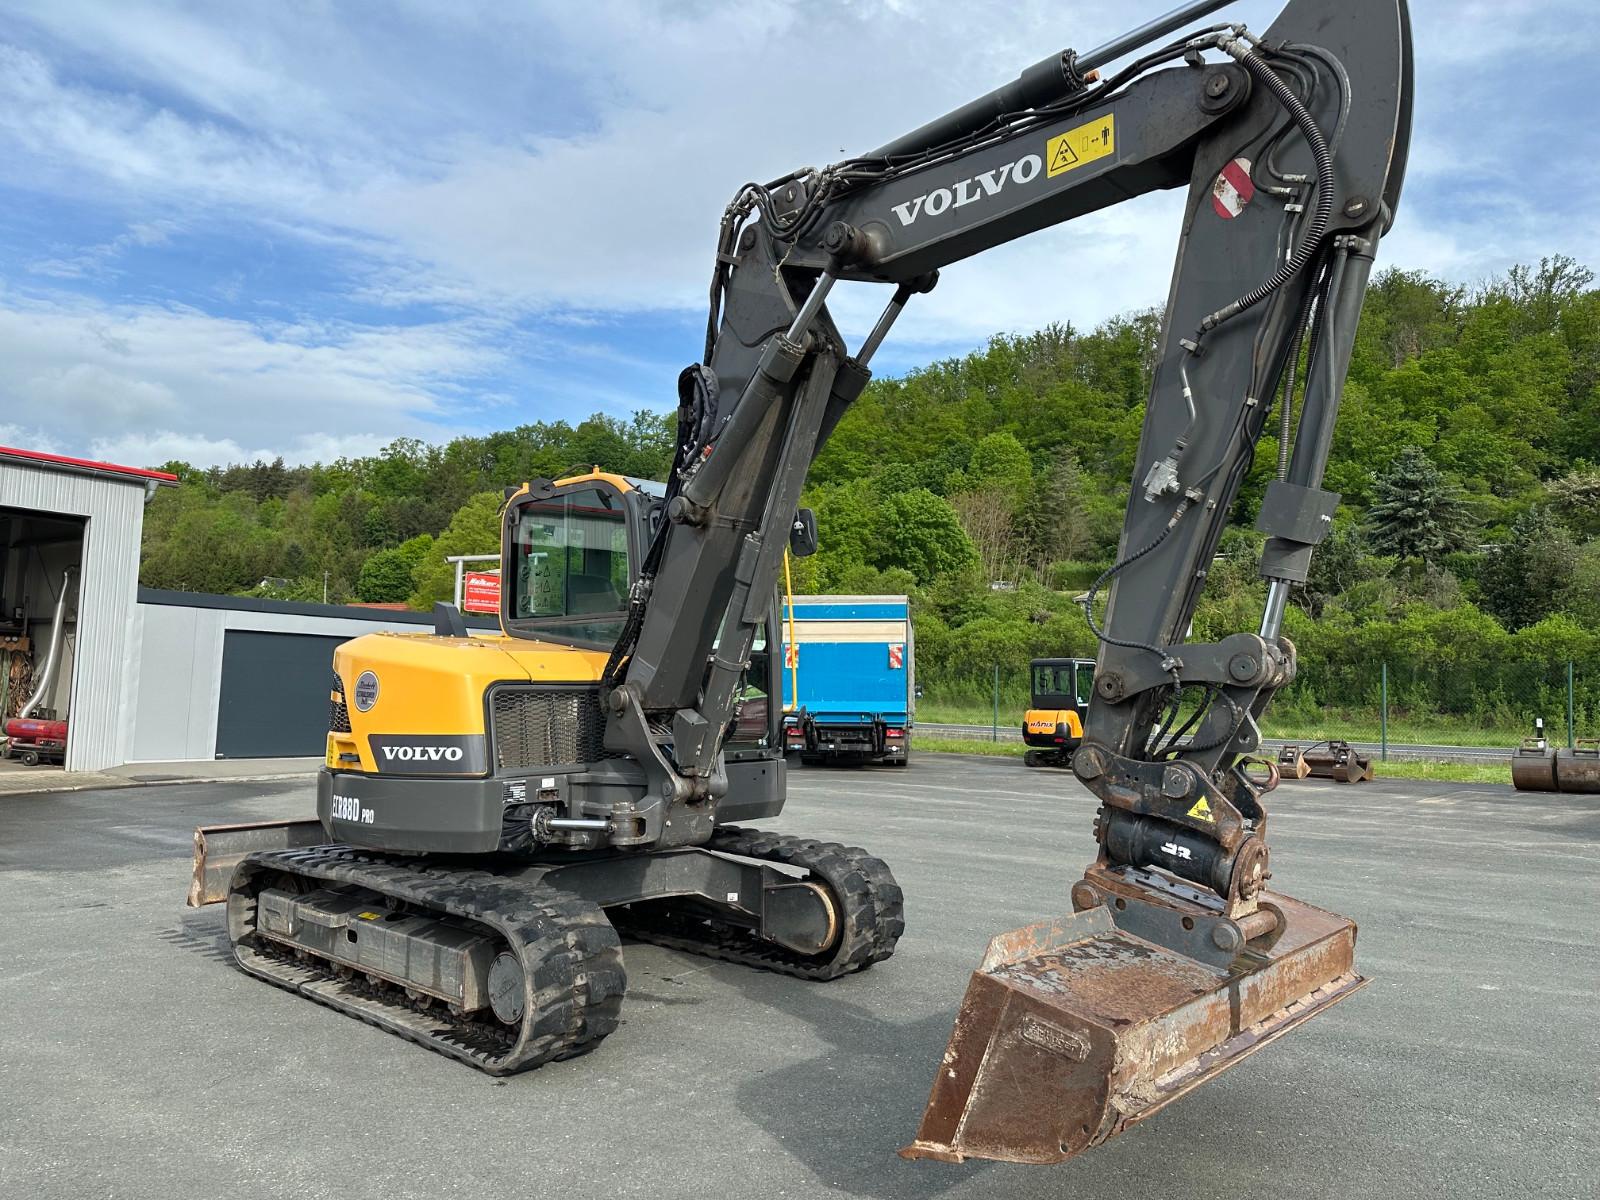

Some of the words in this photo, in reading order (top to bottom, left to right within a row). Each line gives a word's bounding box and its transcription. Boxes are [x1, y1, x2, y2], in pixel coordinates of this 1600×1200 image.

[891, 154, 1042, 226] VOLVO
[382, 746, 463, 761] VOLVO
[332, 794, 360, 822] ECR88D
[361, 808, 375, 825] PRO
